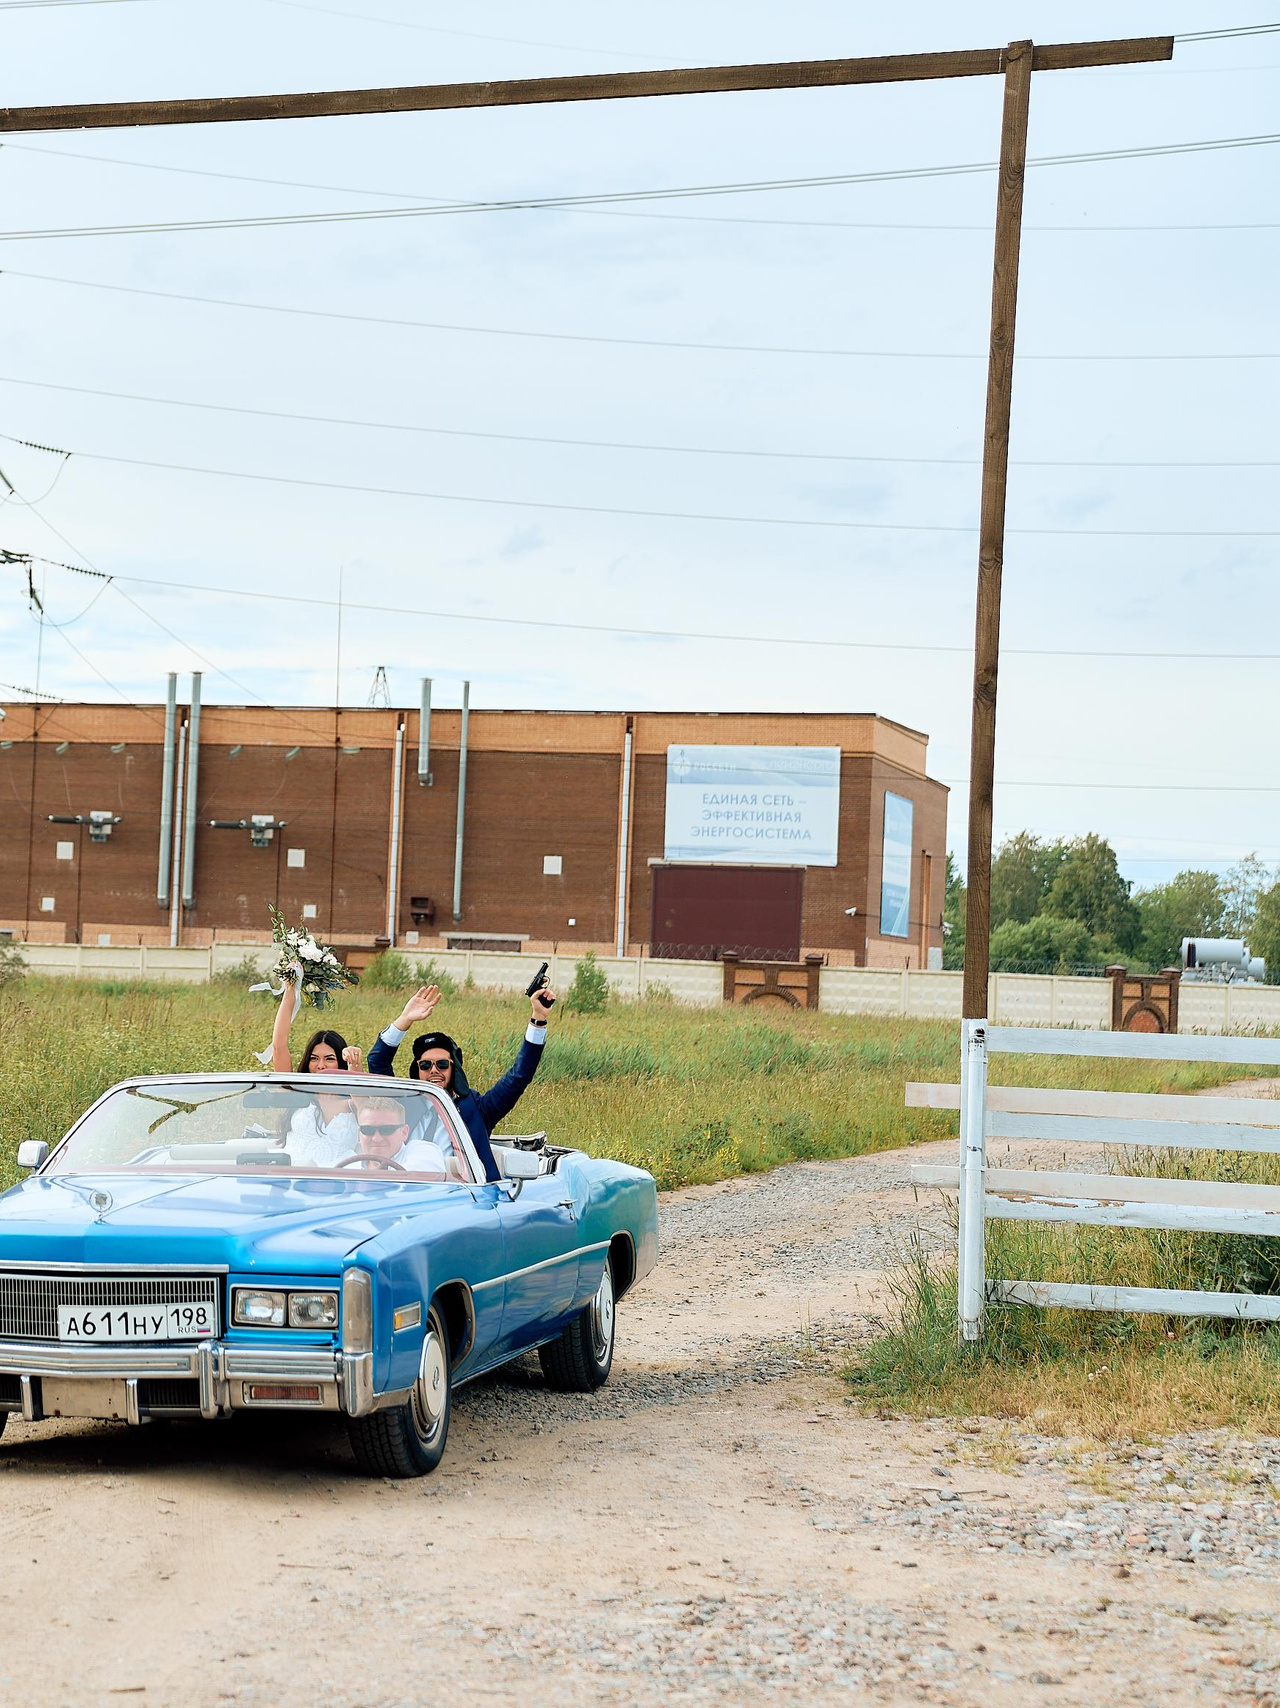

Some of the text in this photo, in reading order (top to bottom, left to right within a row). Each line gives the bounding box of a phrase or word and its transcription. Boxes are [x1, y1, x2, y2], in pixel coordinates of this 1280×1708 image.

[702, 793, 758, 806] ЕДИНАЯ
[762, 794, 794, 807] СЕТЬ
[702, 809, 802, 823] ЭФФЕКТИВНАЯ
[690, 826, 812, 840] ЭНЕРГОСИСТЕМА
[67, 1307, 207, 1336] А611НУ 198
[177, 1325, 197, 1335] RUS
